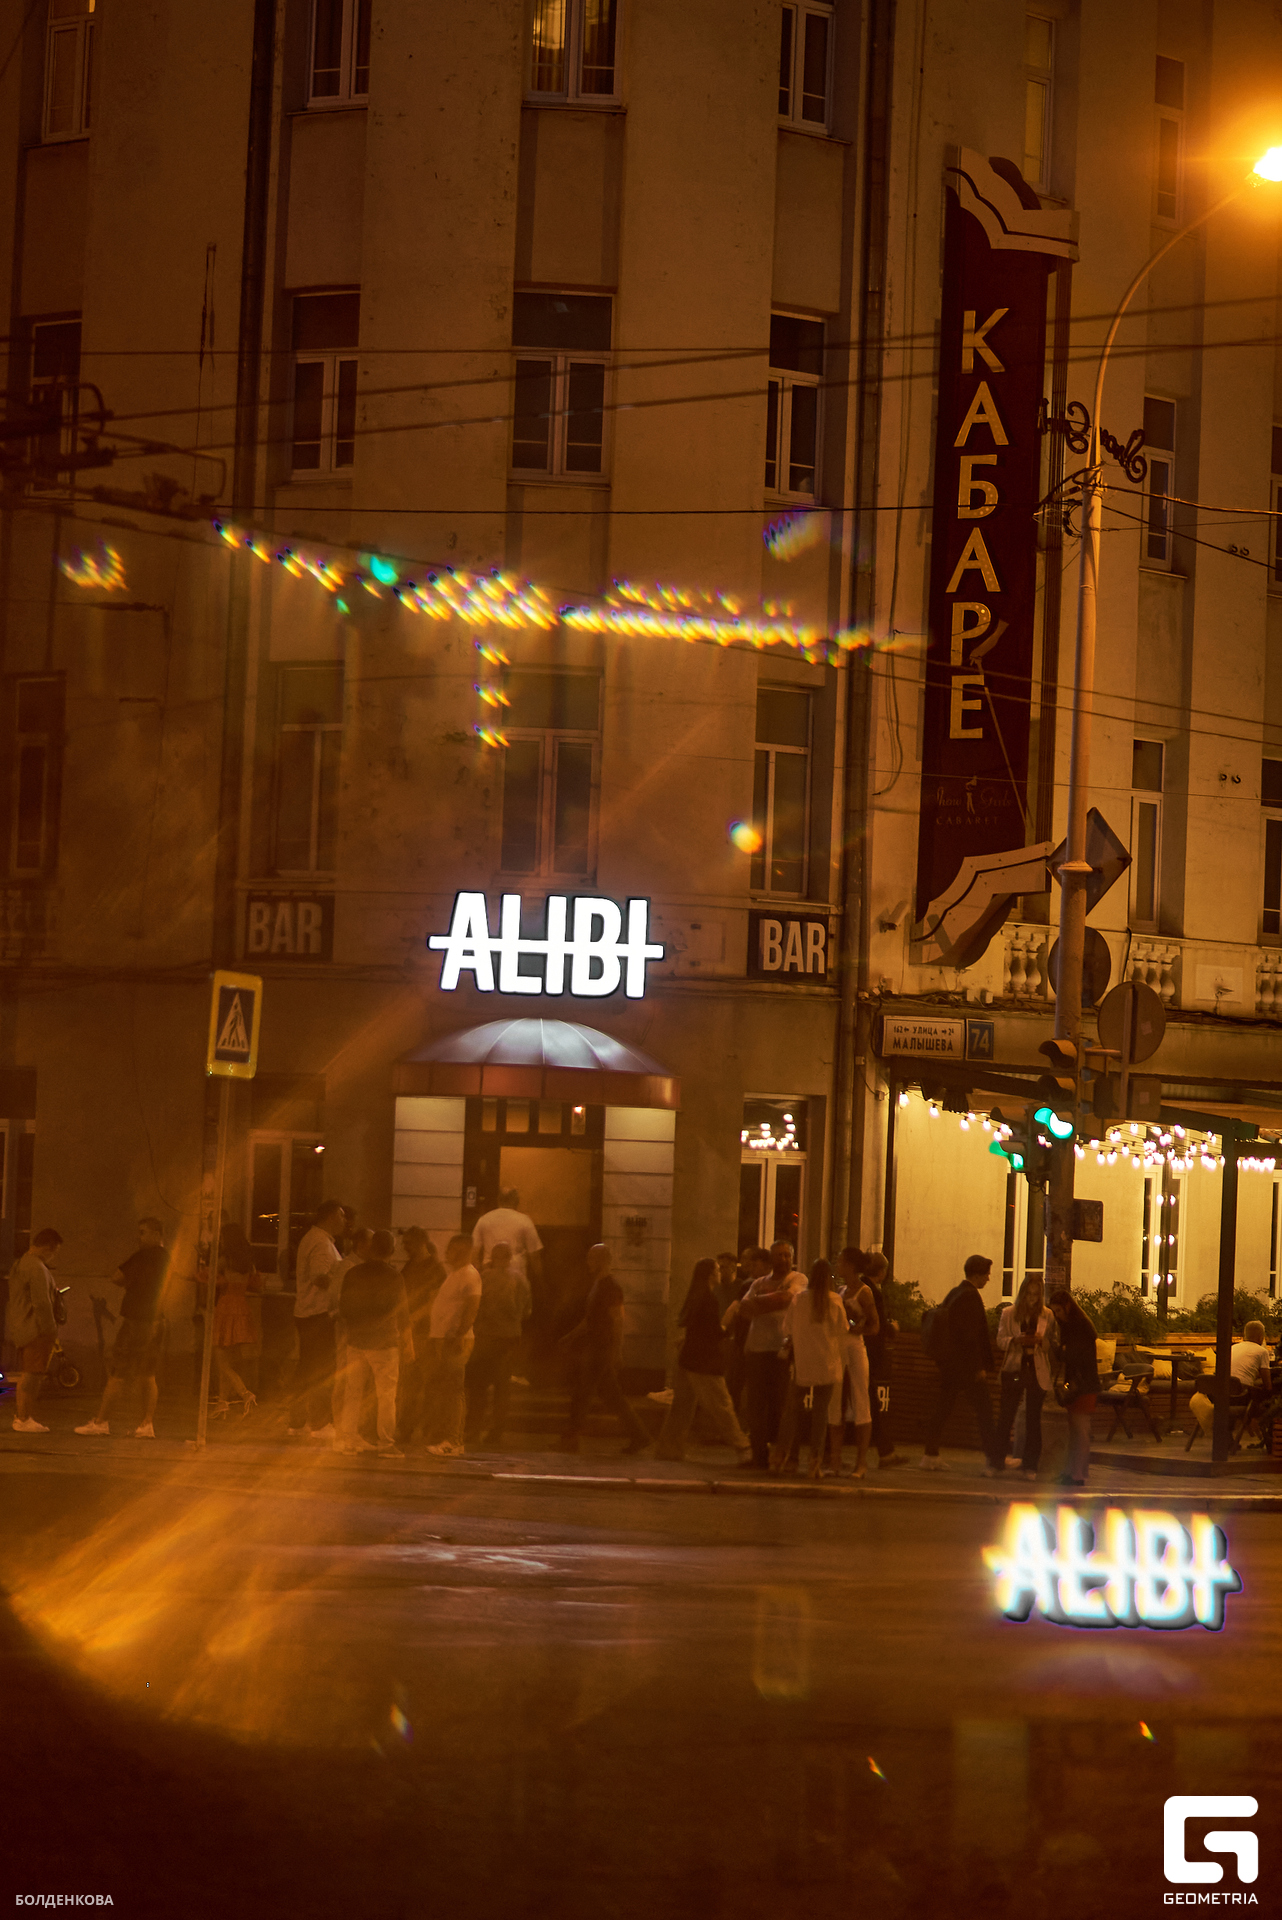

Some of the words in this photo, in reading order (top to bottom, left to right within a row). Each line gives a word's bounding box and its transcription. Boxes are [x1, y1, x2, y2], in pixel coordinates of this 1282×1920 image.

[944, 307, 1009, 739] КАБАРЕ
[936, 816, 999, 825] CABARET
[248, 902, 323, 954] BAR
[428, 891, 664, 999] ALIBI
[760, 918, 826, 974] BAR
[892, 1036, 954, 1052] МАЛЫШЕВА
[912, 1026, 938, 1037] УЛИЦА
[970, 1027, 990, 1053] 74
[981, 1502, 1236, 1628] ALIBI
